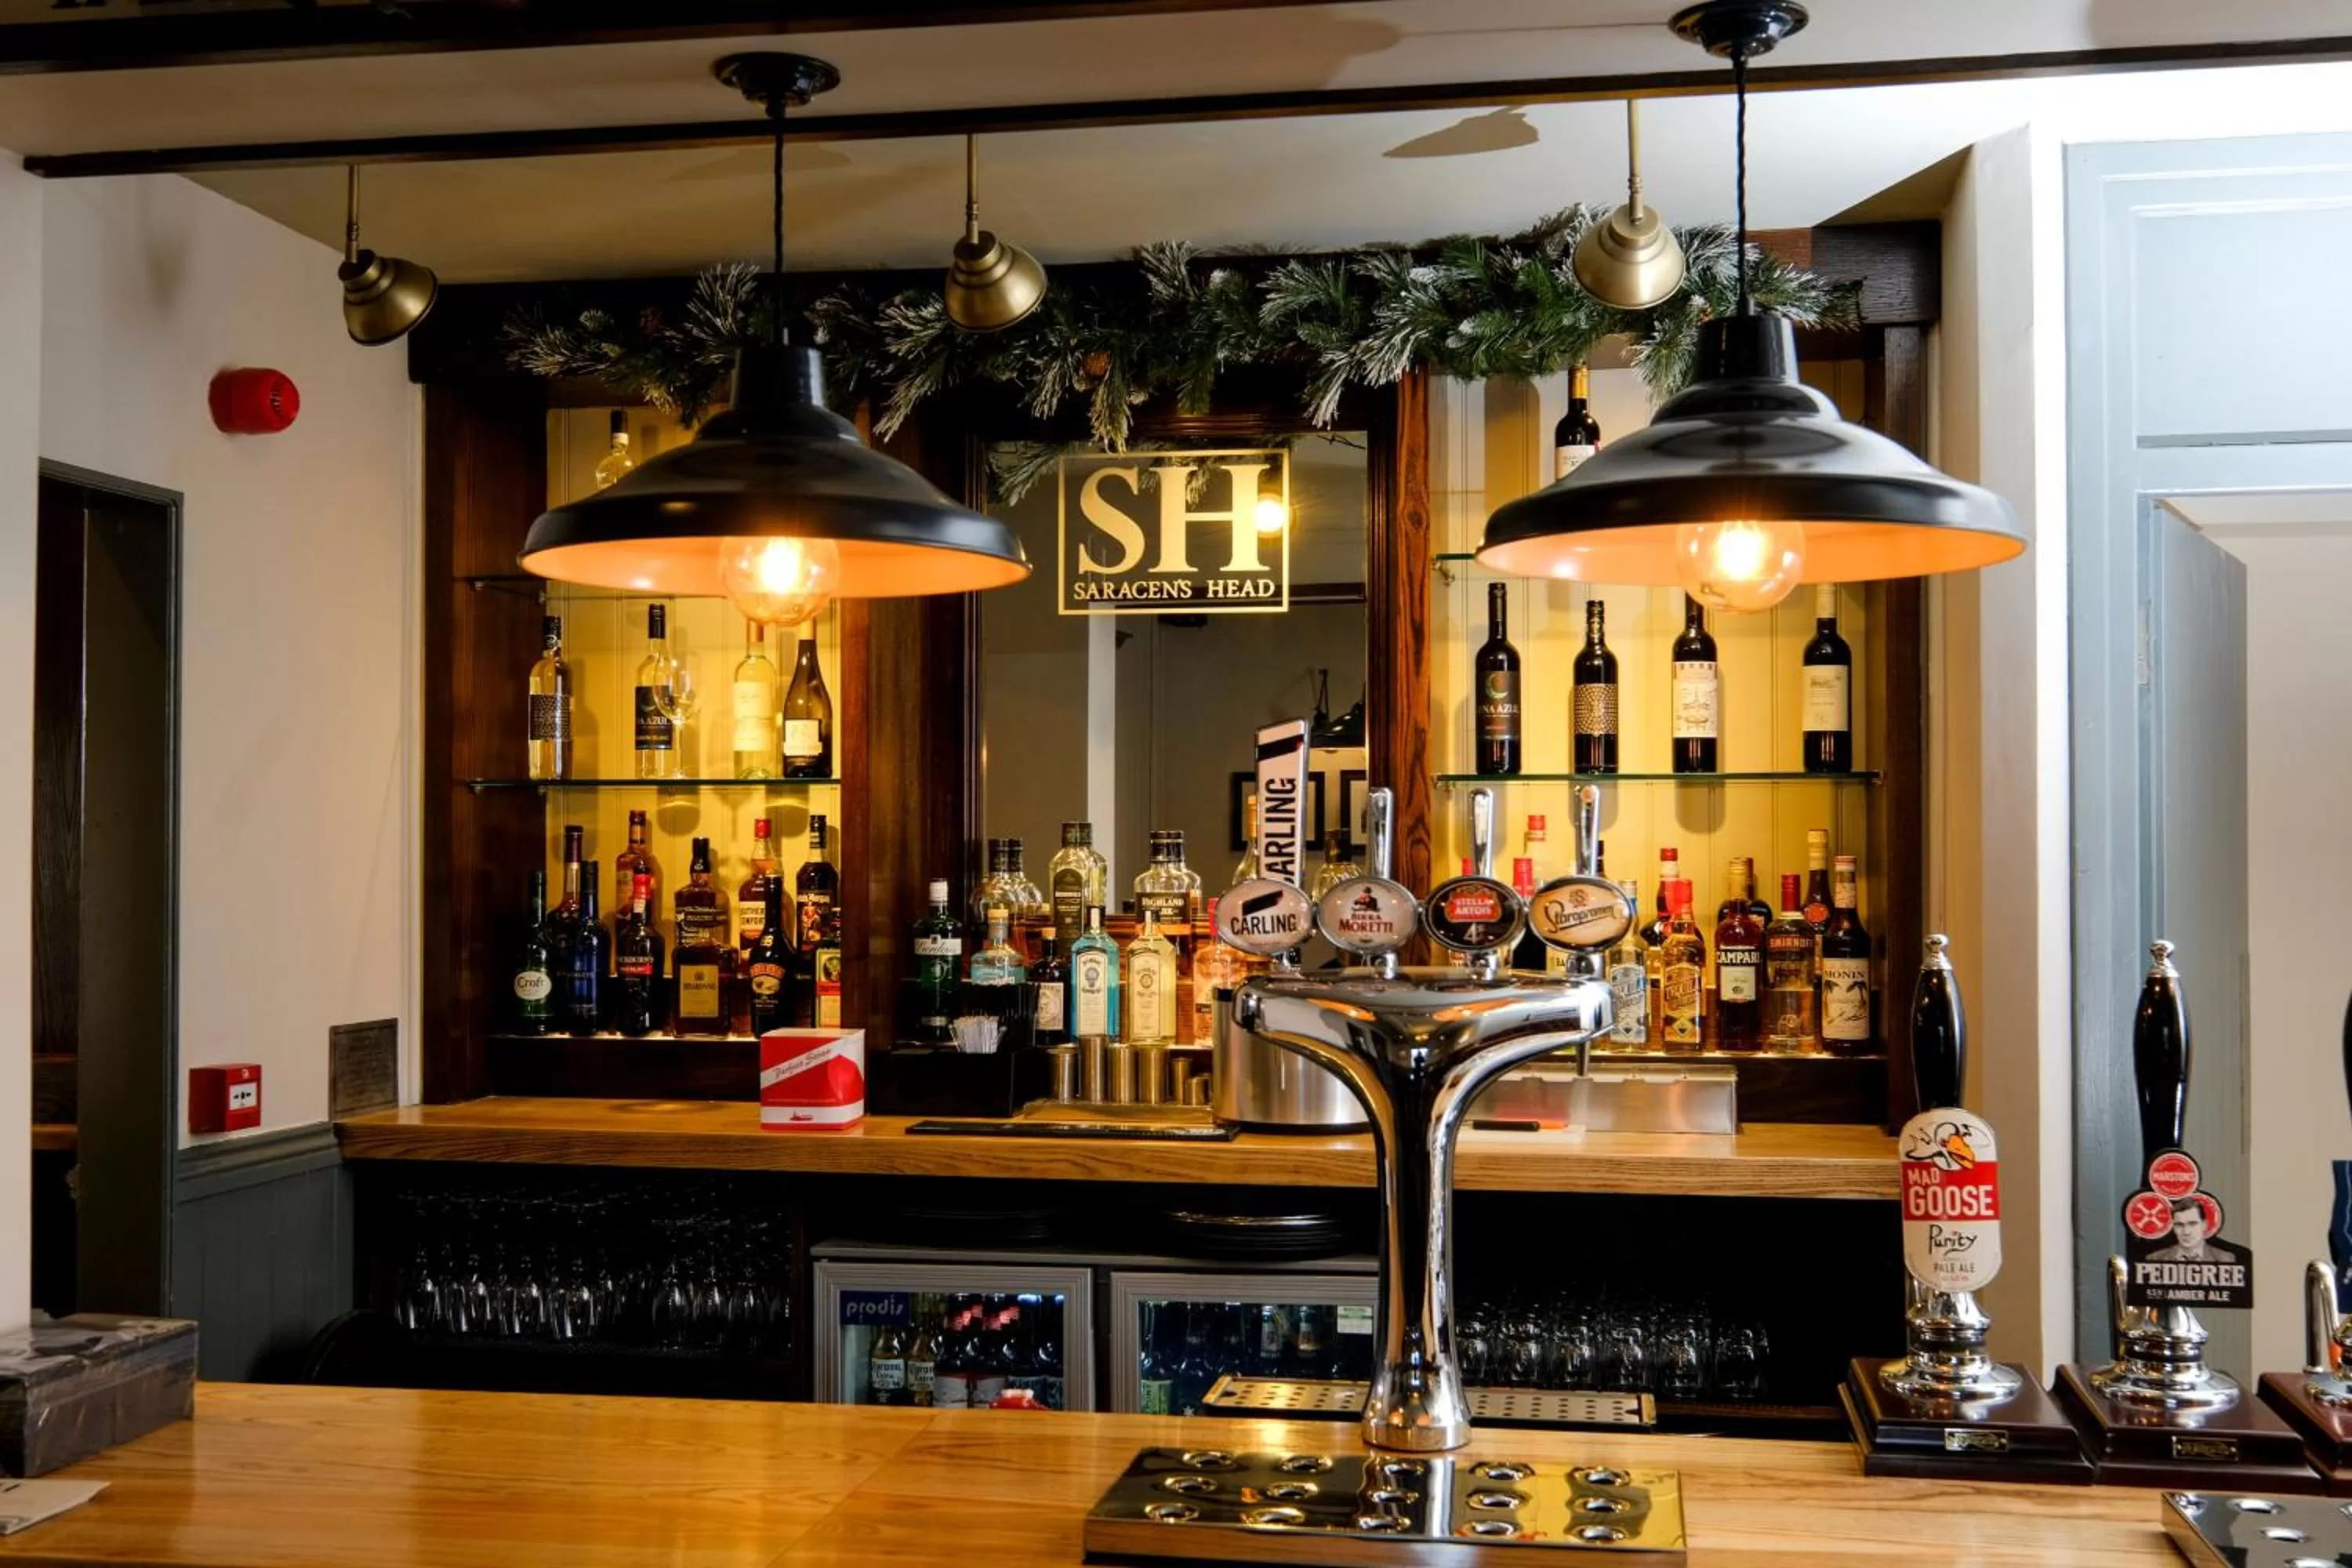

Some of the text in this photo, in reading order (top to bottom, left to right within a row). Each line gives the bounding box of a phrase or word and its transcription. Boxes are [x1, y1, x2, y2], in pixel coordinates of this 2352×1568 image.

[1078, 464, 1270, 574] SH
[1207, 579, 1276, 598] HEAD
[1230, 913, 1298, 935] CARLING
[1338, 918, 1393, 933] MORETTI
[1716, 951, 1760, 963] CAMPARI
[1824, 969, 1866, 979] MONIN
[1907, 1167, 1940, 1185] MAD
[1908, 1185, 1994, 1216] GOOSE
[1929, 1224, 1977, 1255] Purity
[1959, 1262, 1976, 1273] ALE
[2135, 1262, 2245, 1287] PEDIGREE
[2168, 1290, 2205, 1301] AMBER
[2208, 1290, 2230, 1301] ALE
[847, 1295, 903, 1318] prodis
